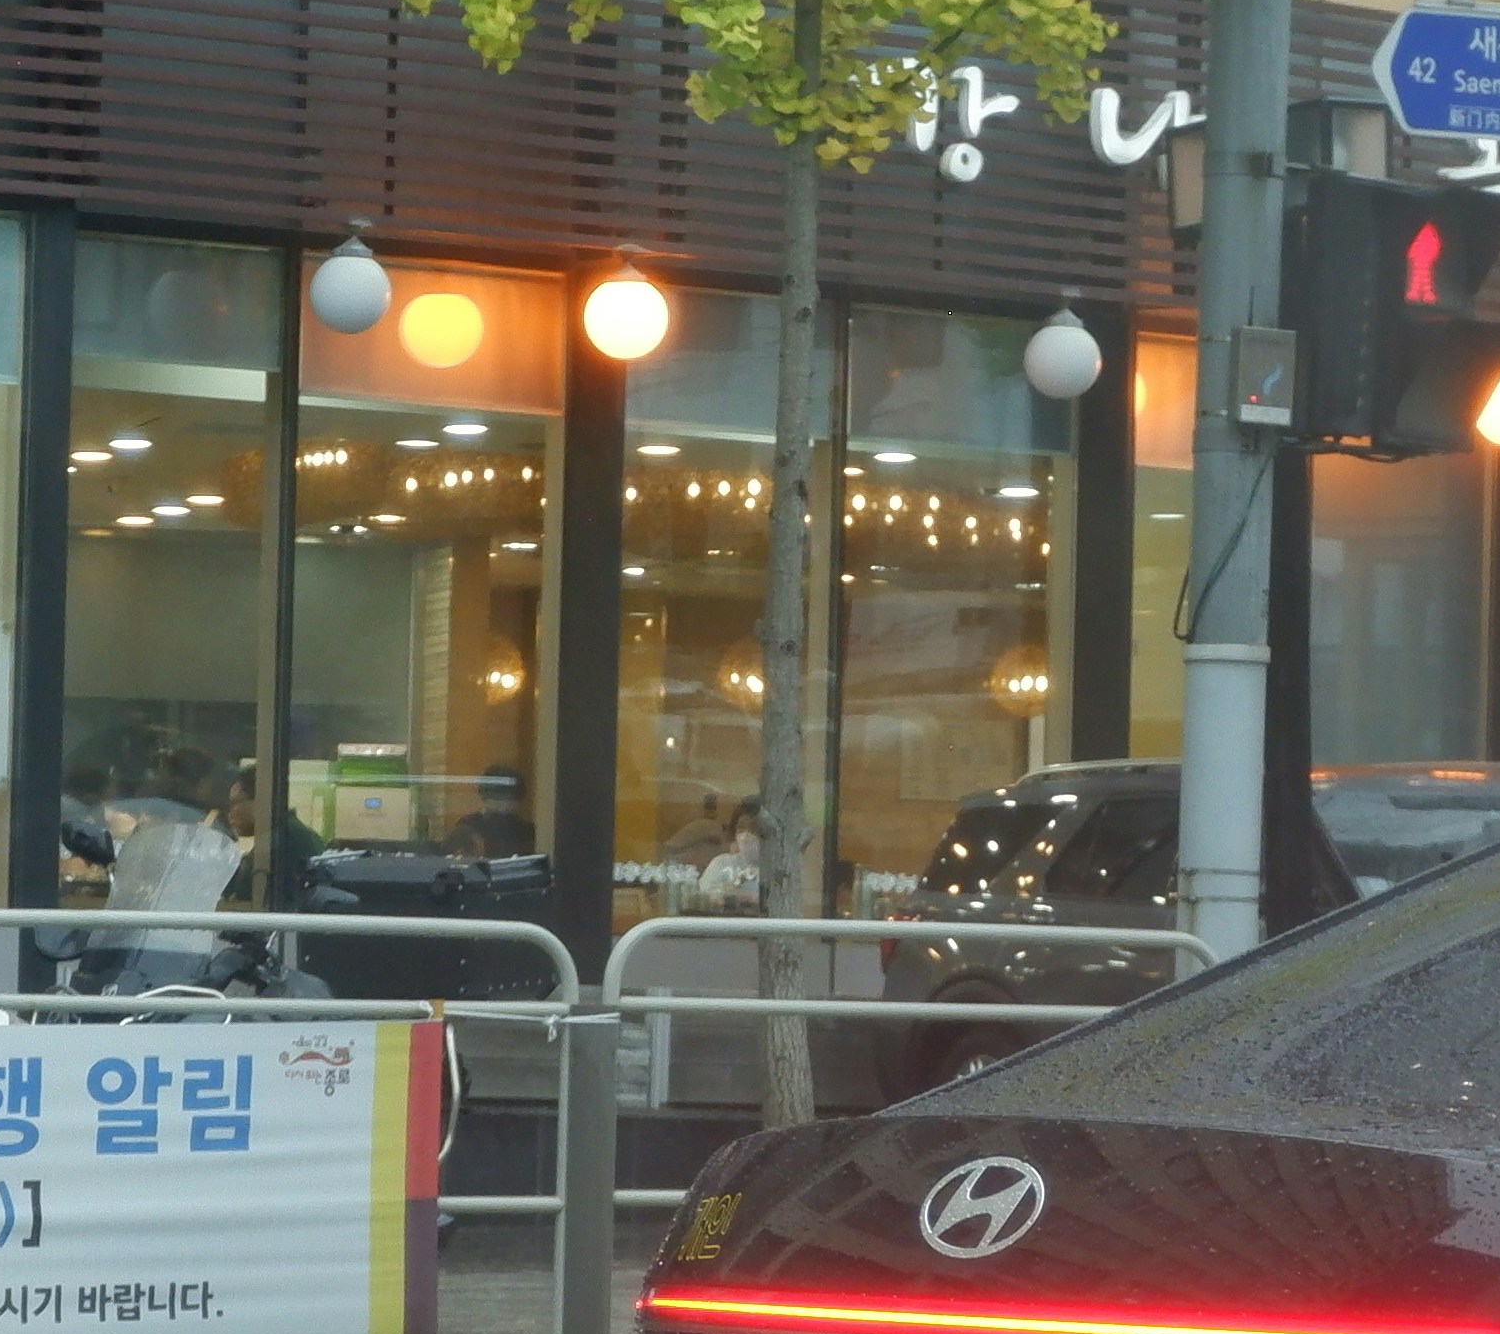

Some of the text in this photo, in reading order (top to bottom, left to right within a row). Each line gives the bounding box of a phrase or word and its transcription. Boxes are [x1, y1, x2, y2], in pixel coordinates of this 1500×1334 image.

[1407, 57, 1437, 84] 42
[86, 1053, 254, 1153] 알림
[77, 1283, 226, 1323] 바랍니다.
